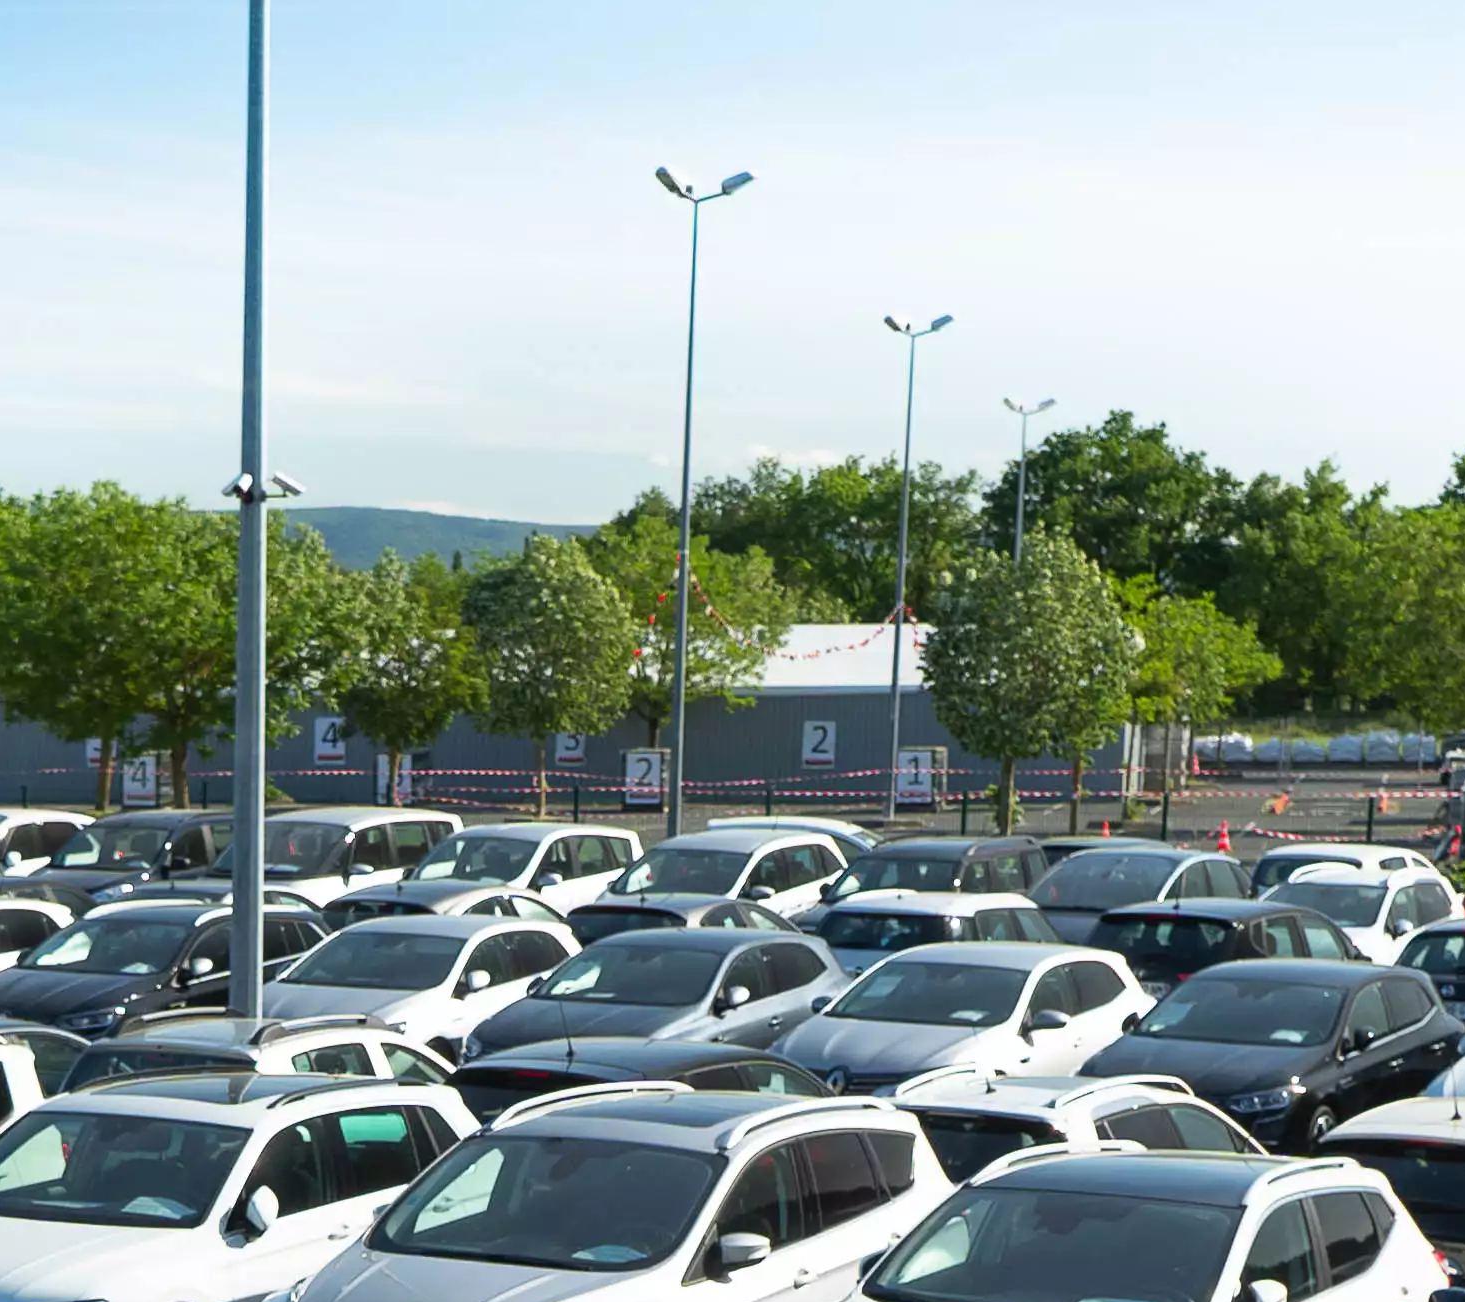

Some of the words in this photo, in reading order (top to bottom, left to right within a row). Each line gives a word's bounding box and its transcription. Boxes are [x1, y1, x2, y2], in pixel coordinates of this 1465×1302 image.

[321, 717, 341, 749] 4
[811, 725, 829, 754] 2
[131, 761, 150, 789] 4
[636, 758, 653, 786] 2
[907, 755, 923, 786] 1
